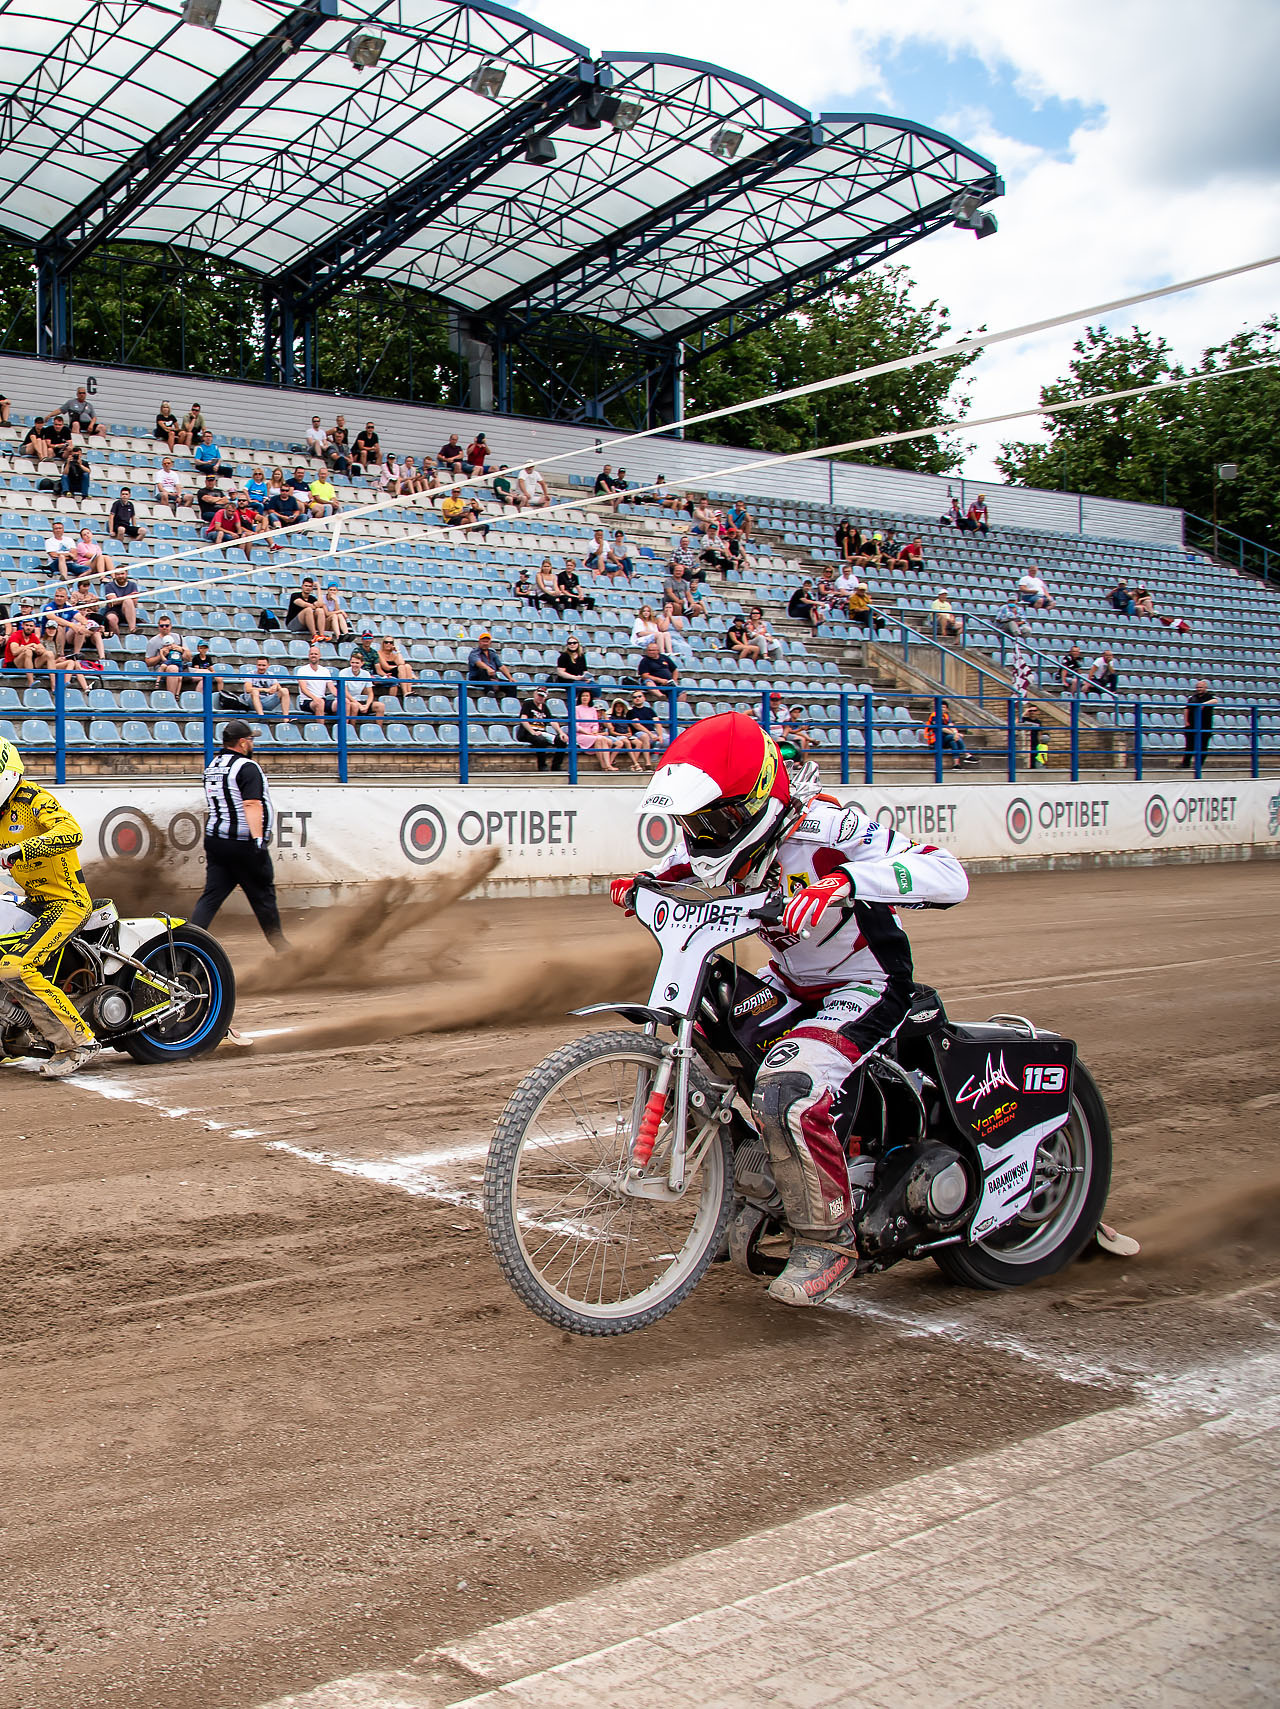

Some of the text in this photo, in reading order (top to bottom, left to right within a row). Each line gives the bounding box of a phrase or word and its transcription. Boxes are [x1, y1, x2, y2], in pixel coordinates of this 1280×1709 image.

[875, 804, 958, 835] OPTIBET
[1038, 800, 1110, 829] OPTIBET
[1174, 796, 1238, 823] OPTIBET
[458, 810, 578, 846] OPTIBET
[276, 851, 312, 862] ĀRS
[537, 847, 577, 857] BĀRS
[673, 904, 744, 928] OPTIBET
[710, 925, 736, 934] BĀRS
[733, 987, 774, 1016] GORINA
[1024, 1066, 1066, 1092] 113
[981, 1113, 1016, 1137] LONDON
[997, 1176, 1025, 1196] FAMILY
